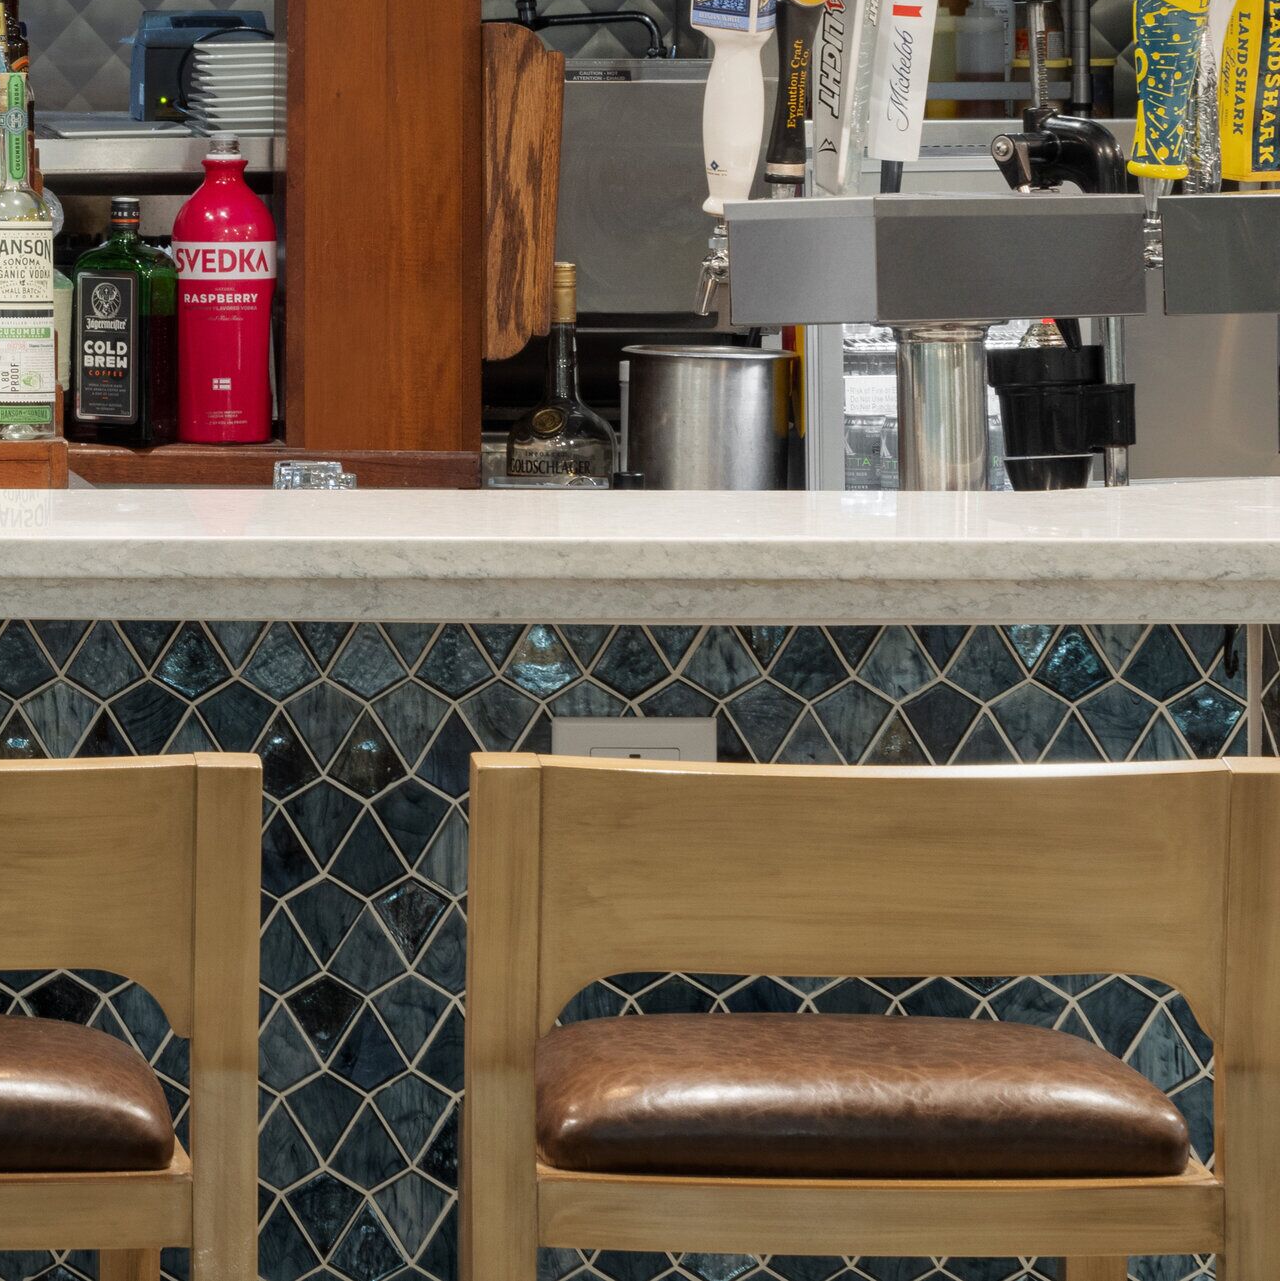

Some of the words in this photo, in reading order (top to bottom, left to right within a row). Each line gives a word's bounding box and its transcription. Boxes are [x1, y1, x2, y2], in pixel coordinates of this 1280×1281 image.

[790, 39, 804, 70] Craft
[800, 48, 810, 66] Co.
[819, 12, 845, 119] LIGHT
[888, 30, 915, 131] Michelob
[1222, 47, 1235, 96] Lager
[1233, 12, 1251, 136] LANDSHARK
[1259, 1, 1280, 164] LANDSHARK
[787, 72, 798, 129] Evolution
[797, 68, 806, 118] Brewing
[3, 258, 40, 266] SONOMA
[28, 269, 51, 279] VODKA
[176, 248, 270, 273] SVEDKA
[184, 292, 259, 304] RASPBERRY
[84, 340, 128, 355] COLD
[84, 356, 128, 368] BREW
[10, 362, 20, 392] PROOF
